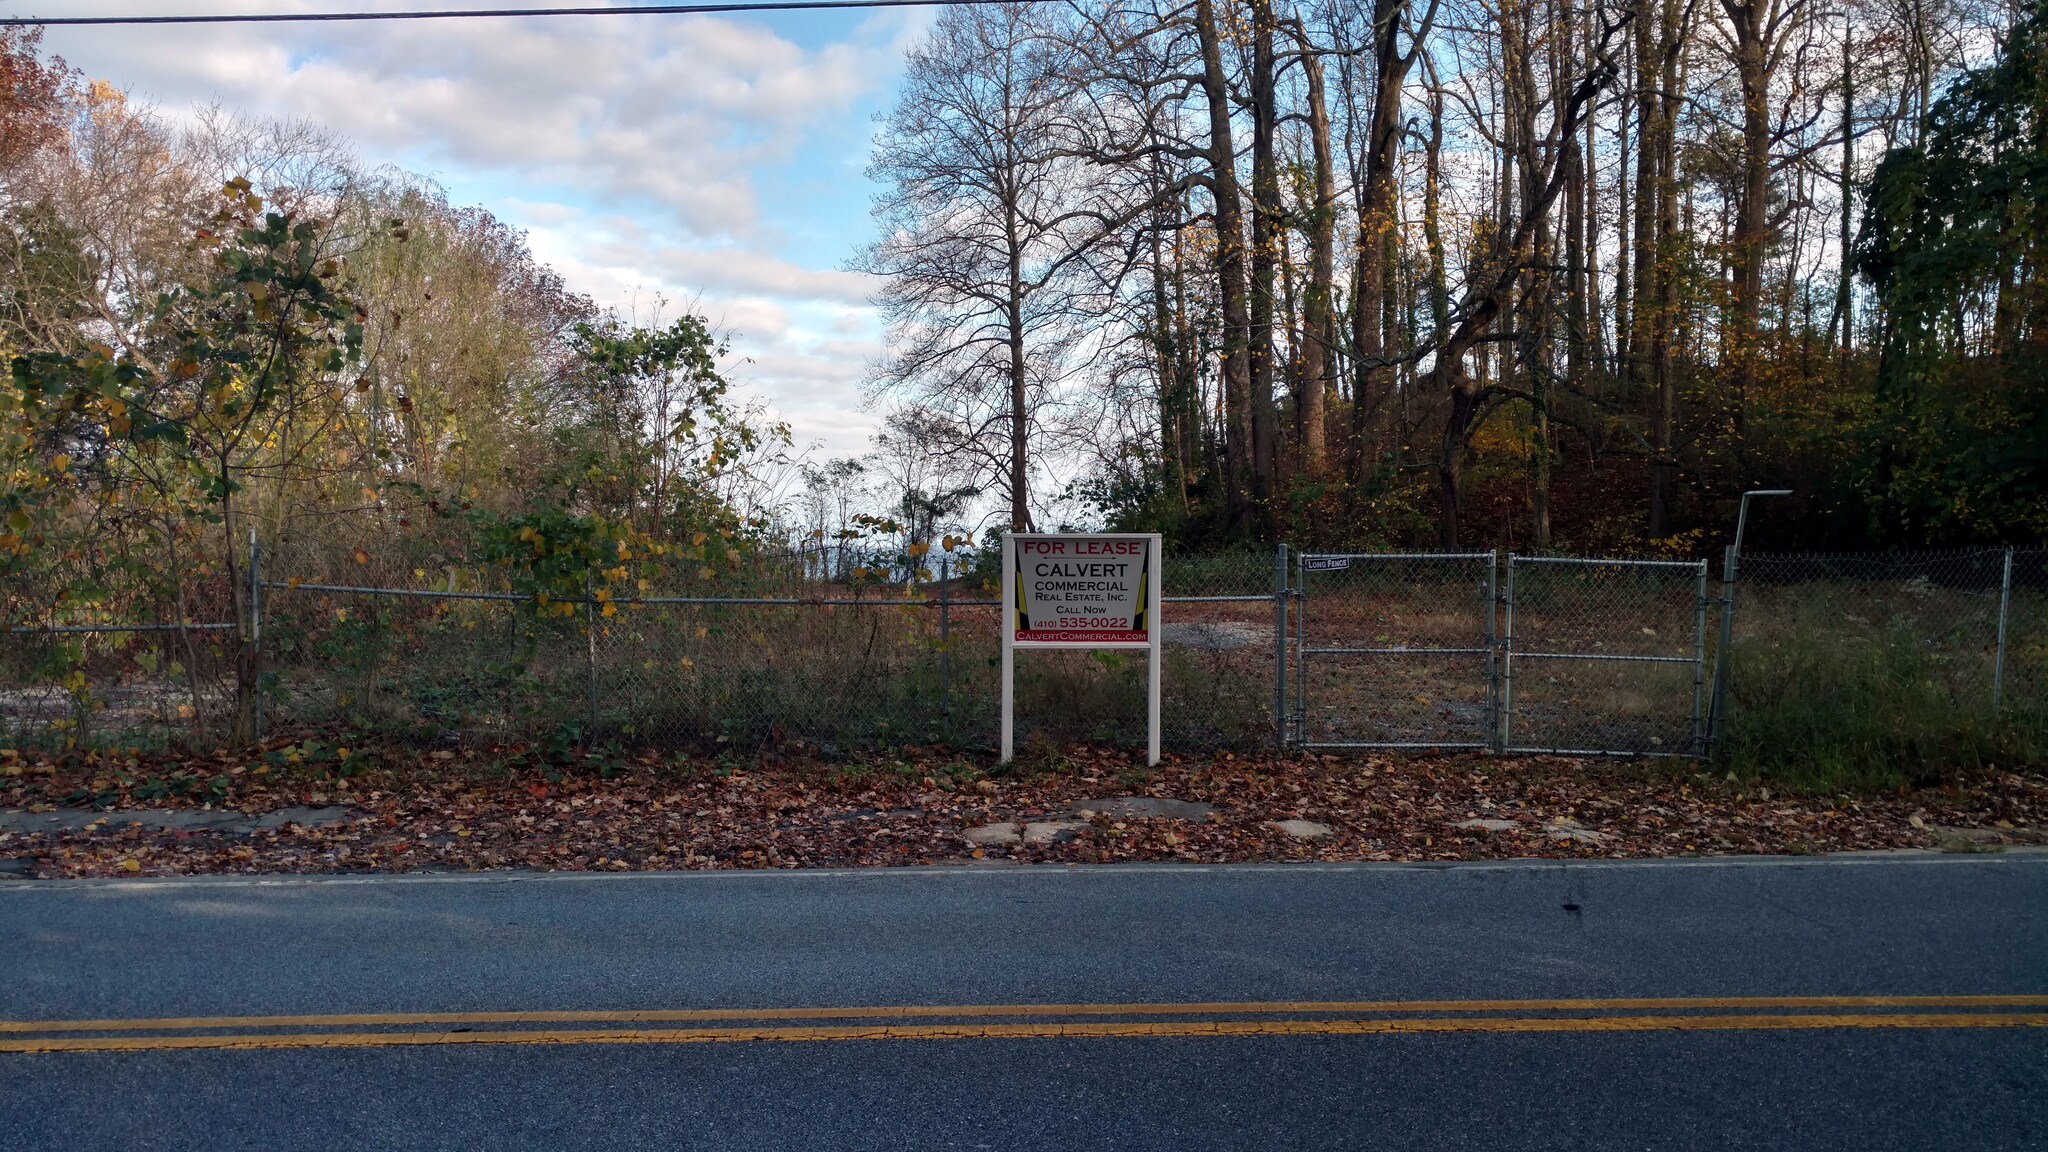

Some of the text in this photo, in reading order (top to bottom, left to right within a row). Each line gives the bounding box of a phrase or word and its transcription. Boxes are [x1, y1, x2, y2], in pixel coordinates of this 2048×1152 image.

[1024, 541, 1141, 555] FOR LEASE
[1308, 559, 1347, 569] LONG FENCE
[1035, 563, 1128, 577] CALVERT
[1035, 581, 1128, 591] COMMERCIAL
[1035, 593, 1062, 601] REAL
[1107, 593, 1127, 601] INC.
[1056, 605, 1107, 614] CALL NOW
[1034, 617, 1128, 628] (410) 535-0022
